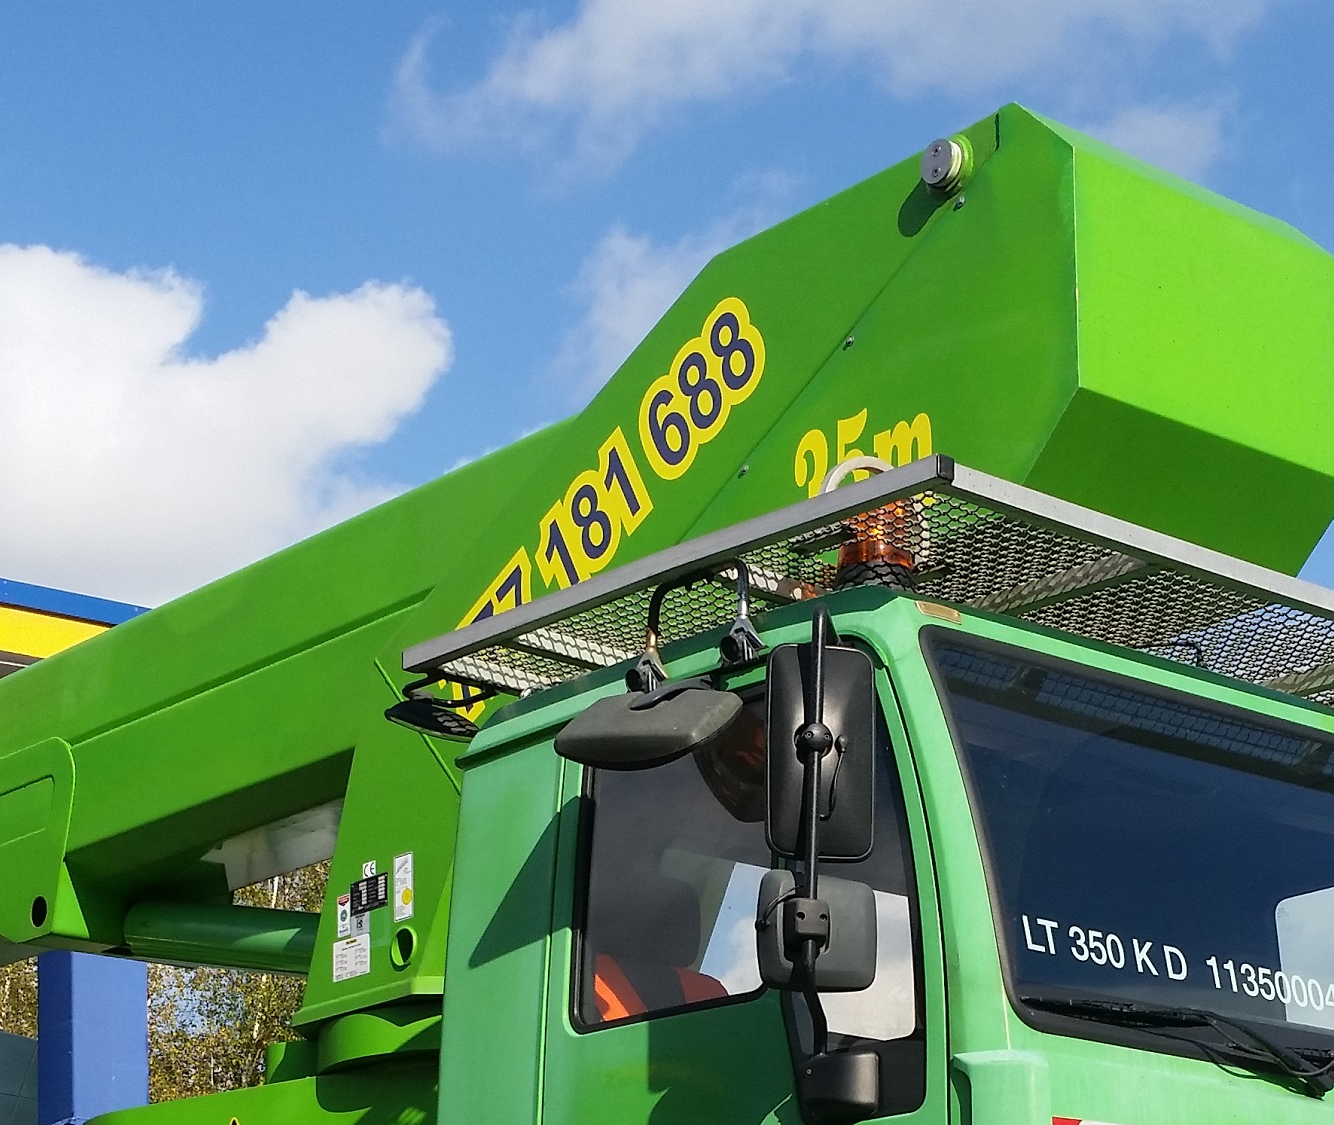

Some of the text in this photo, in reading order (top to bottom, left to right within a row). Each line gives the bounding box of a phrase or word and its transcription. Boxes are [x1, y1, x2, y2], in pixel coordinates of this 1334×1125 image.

[536, 297, 765, 588] 181 688
[1021, 914, 1059, 955] LT
[1068, 925, 1125, 969] 350
[1132, 938, 1159, 976] K
[1163, 945, 1188, 981] D
